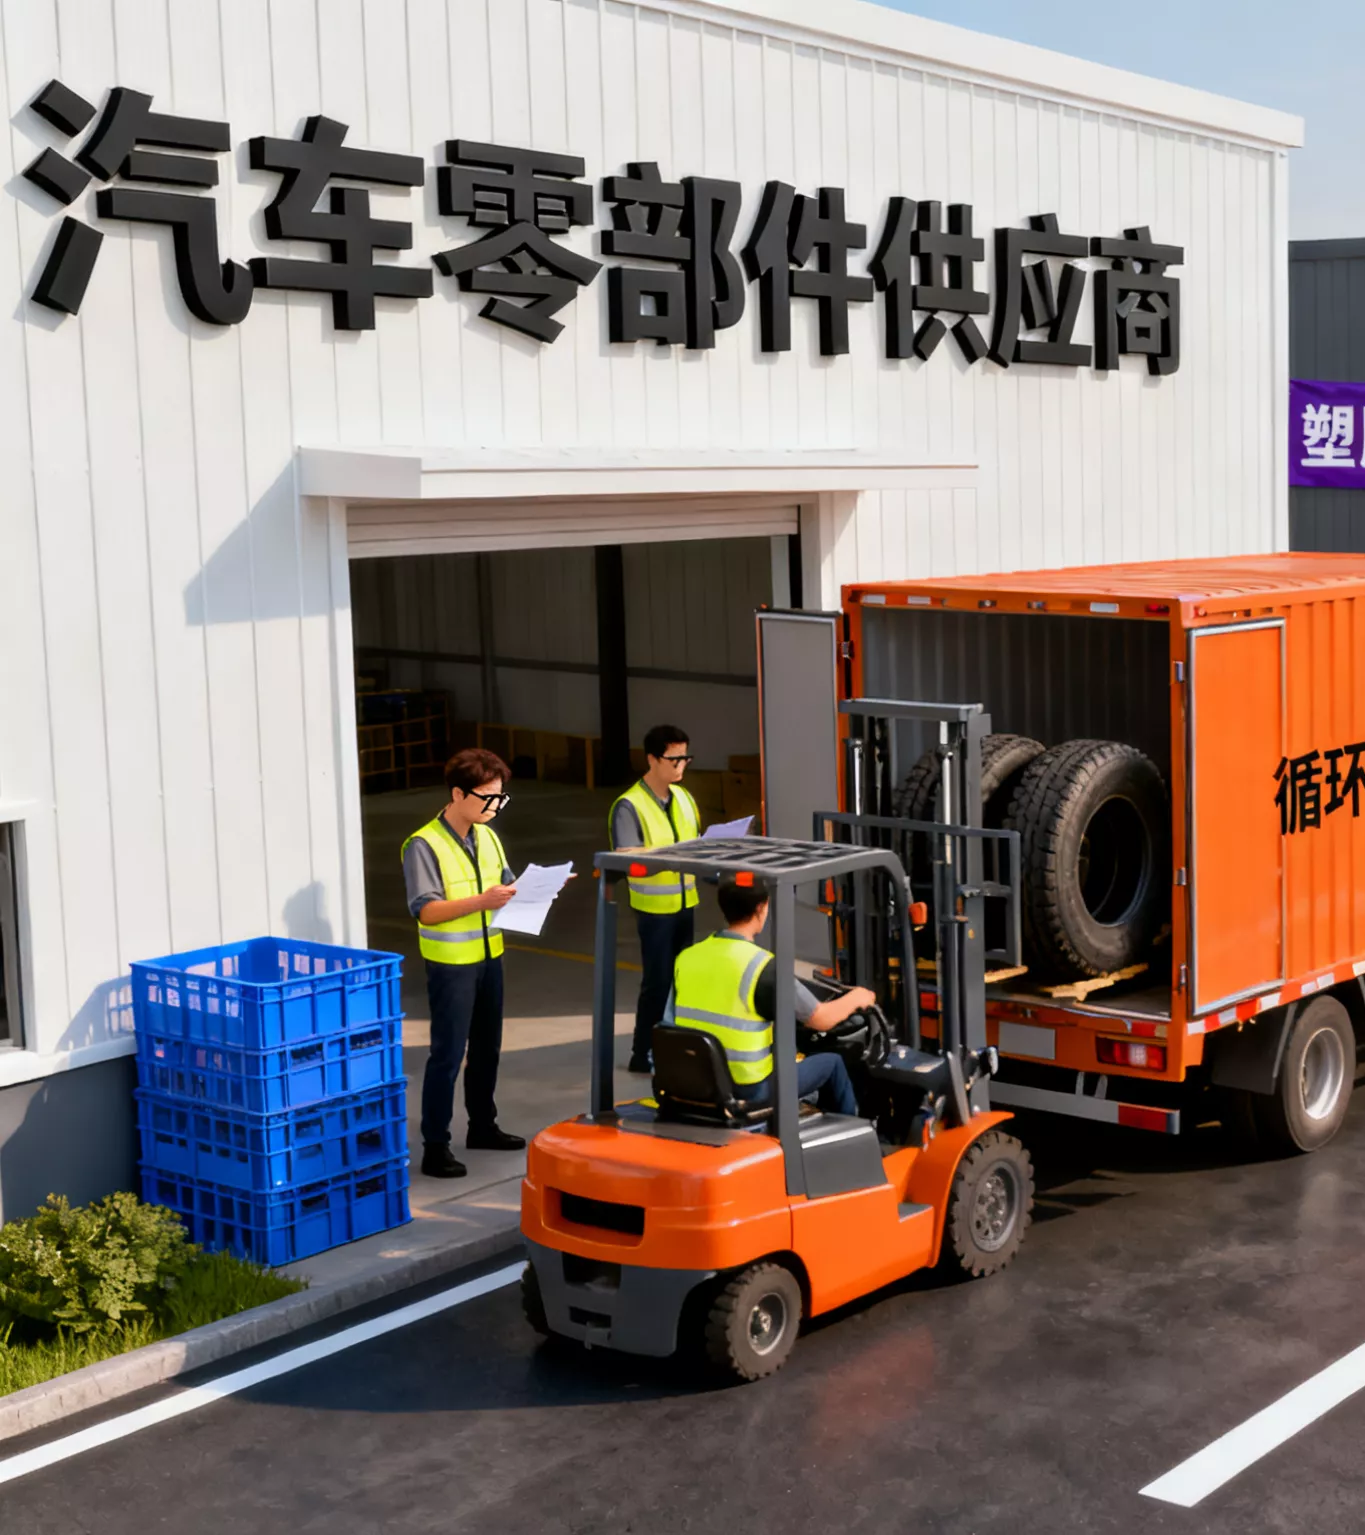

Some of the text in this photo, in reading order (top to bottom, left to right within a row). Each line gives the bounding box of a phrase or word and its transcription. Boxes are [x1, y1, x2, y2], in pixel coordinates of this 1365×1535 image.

[20, 78, 1186, 376] 汽车零部件供应商
